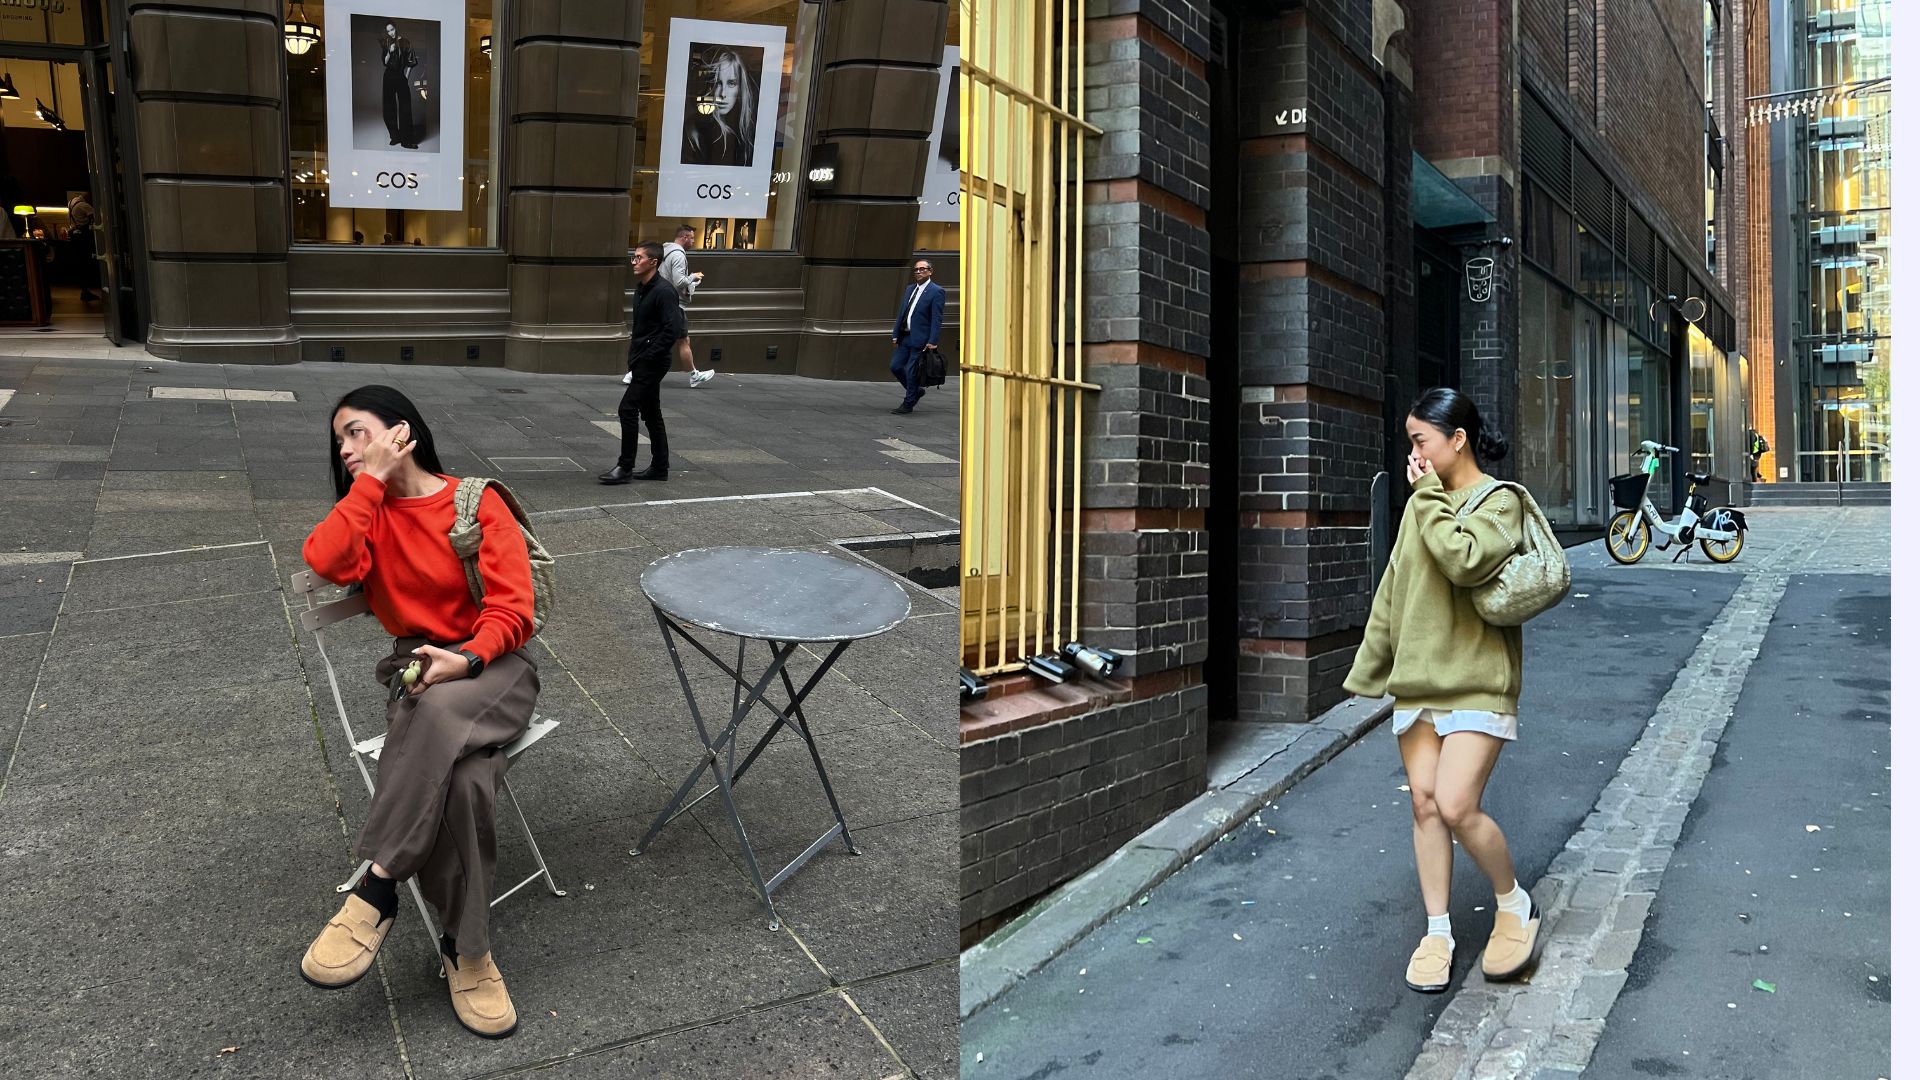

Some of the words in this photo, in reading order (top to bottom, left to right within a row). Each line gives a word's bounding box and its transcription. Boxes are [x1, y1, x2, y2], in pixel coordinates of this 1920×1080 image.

[376, 171, 419, 189] COS
[696, 183, 732, 200] COS
[946, 191, 960, 206] C
